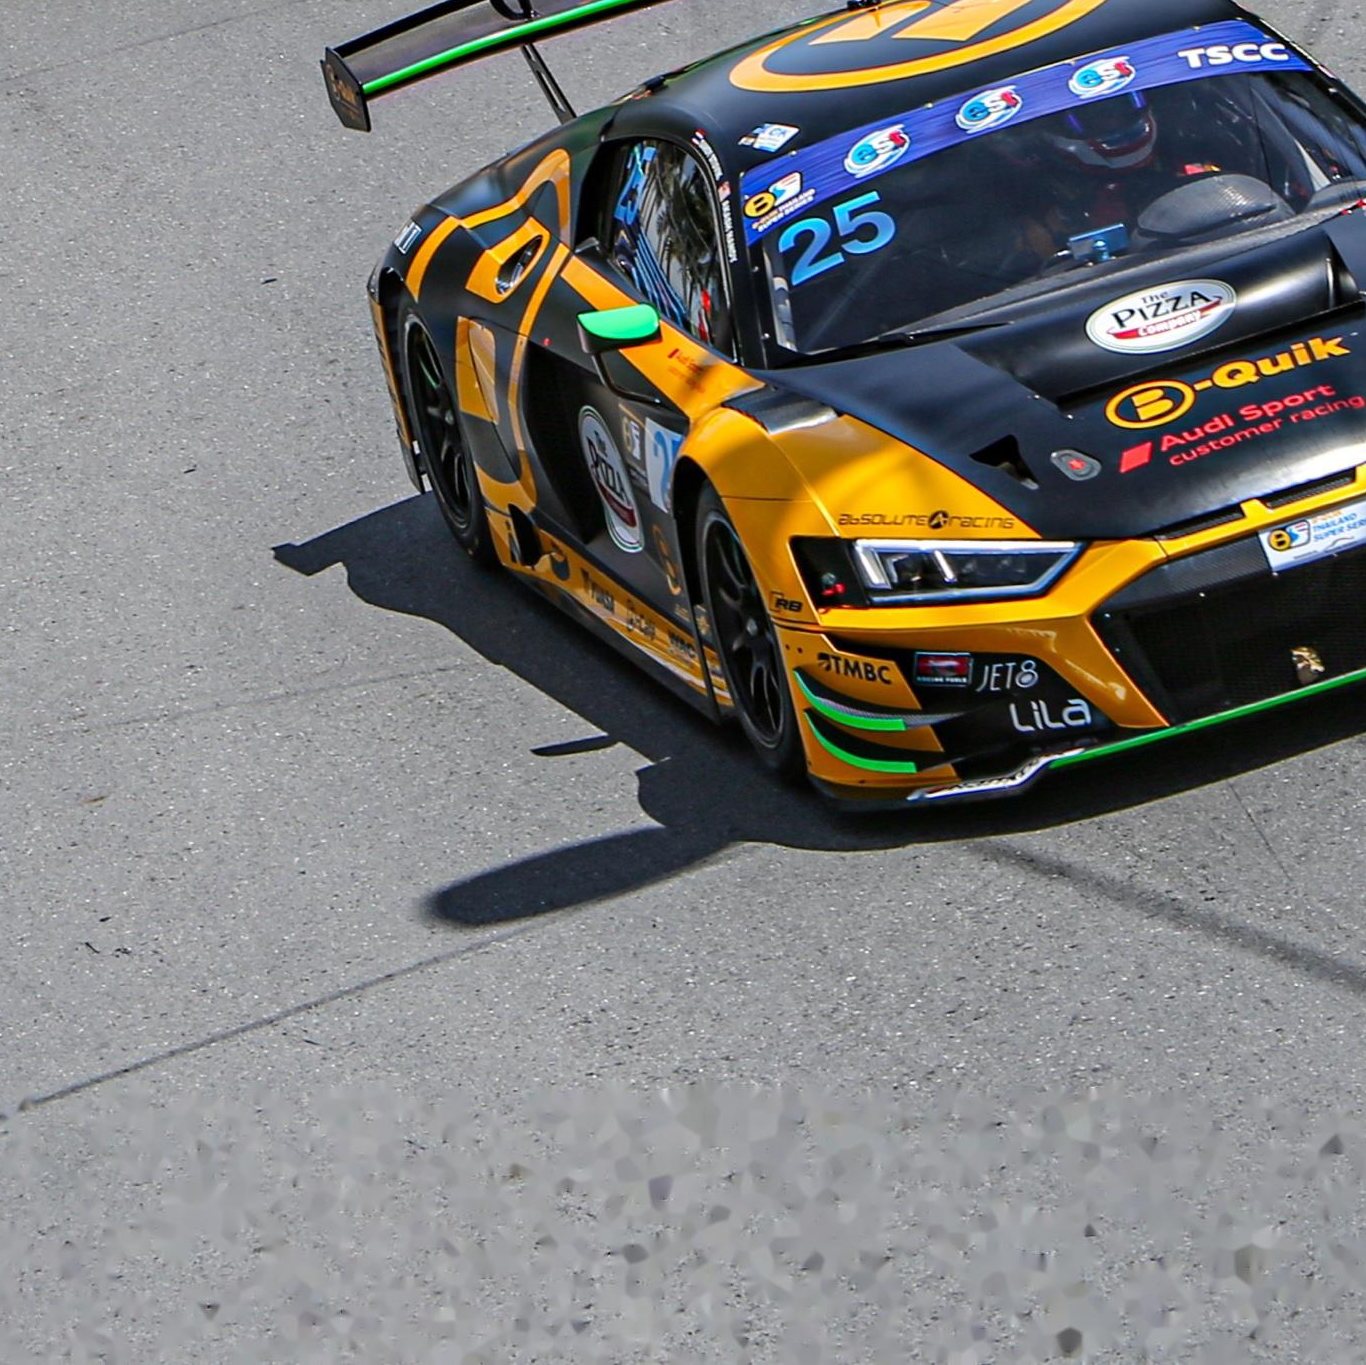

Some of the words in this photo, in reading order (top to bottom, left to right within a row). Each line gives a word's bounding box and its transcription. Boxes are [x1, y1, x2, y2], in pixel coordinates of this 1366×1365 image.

[1178, 43, 1290, 69] TSCC
[778, 190, 897, 286] 25
[1110, 290, 1212, 329] PIZZA
[1140, 290, 1169, 305] The
[1104, 336, 1351, 429] B-Quik
[1160, 413, 1235, 452] Audi
[1238, 384, 1336, 422] Sport
[1169, 417, 1283, 466] customer
[1290, 394, 1366, 424] racing
[831, 655, 893, 685] TMBC
